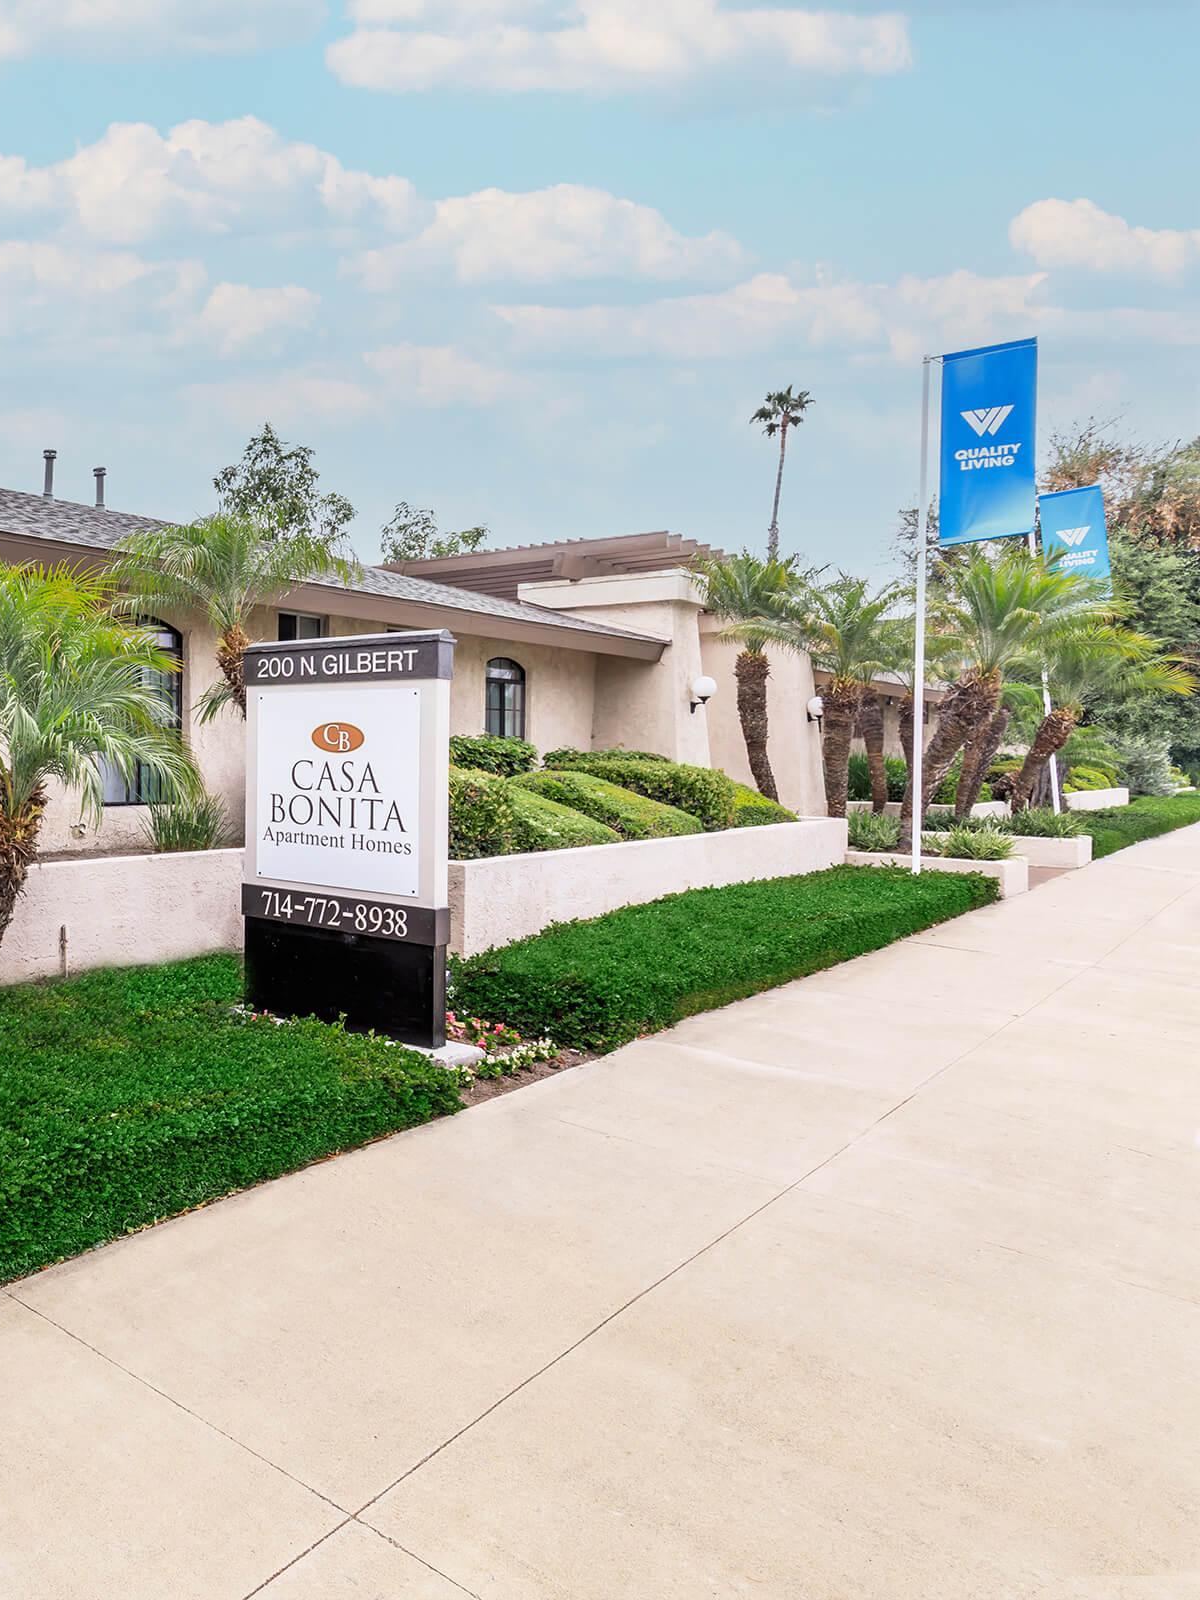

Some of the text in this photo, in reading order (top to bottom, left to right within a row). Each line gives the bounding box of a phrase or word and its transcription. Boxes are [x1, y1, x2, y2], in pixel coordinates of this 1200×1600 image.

[954, 442, 1022, 460] QUALITY
[960, 455, 1016, 471] LIVING
[1060, 549, 1099, 561] UALITY
[257, 649, 419, 679] 200 N. GILBERT
[323, 724, 351, 752] CB
[291, 759, 382, 794] CASA
[270, 793, 409, 833] BONITA
[263, 826, 413, 856] Apartment Homes
[261, 891, 409, 937] 714-772-8938
